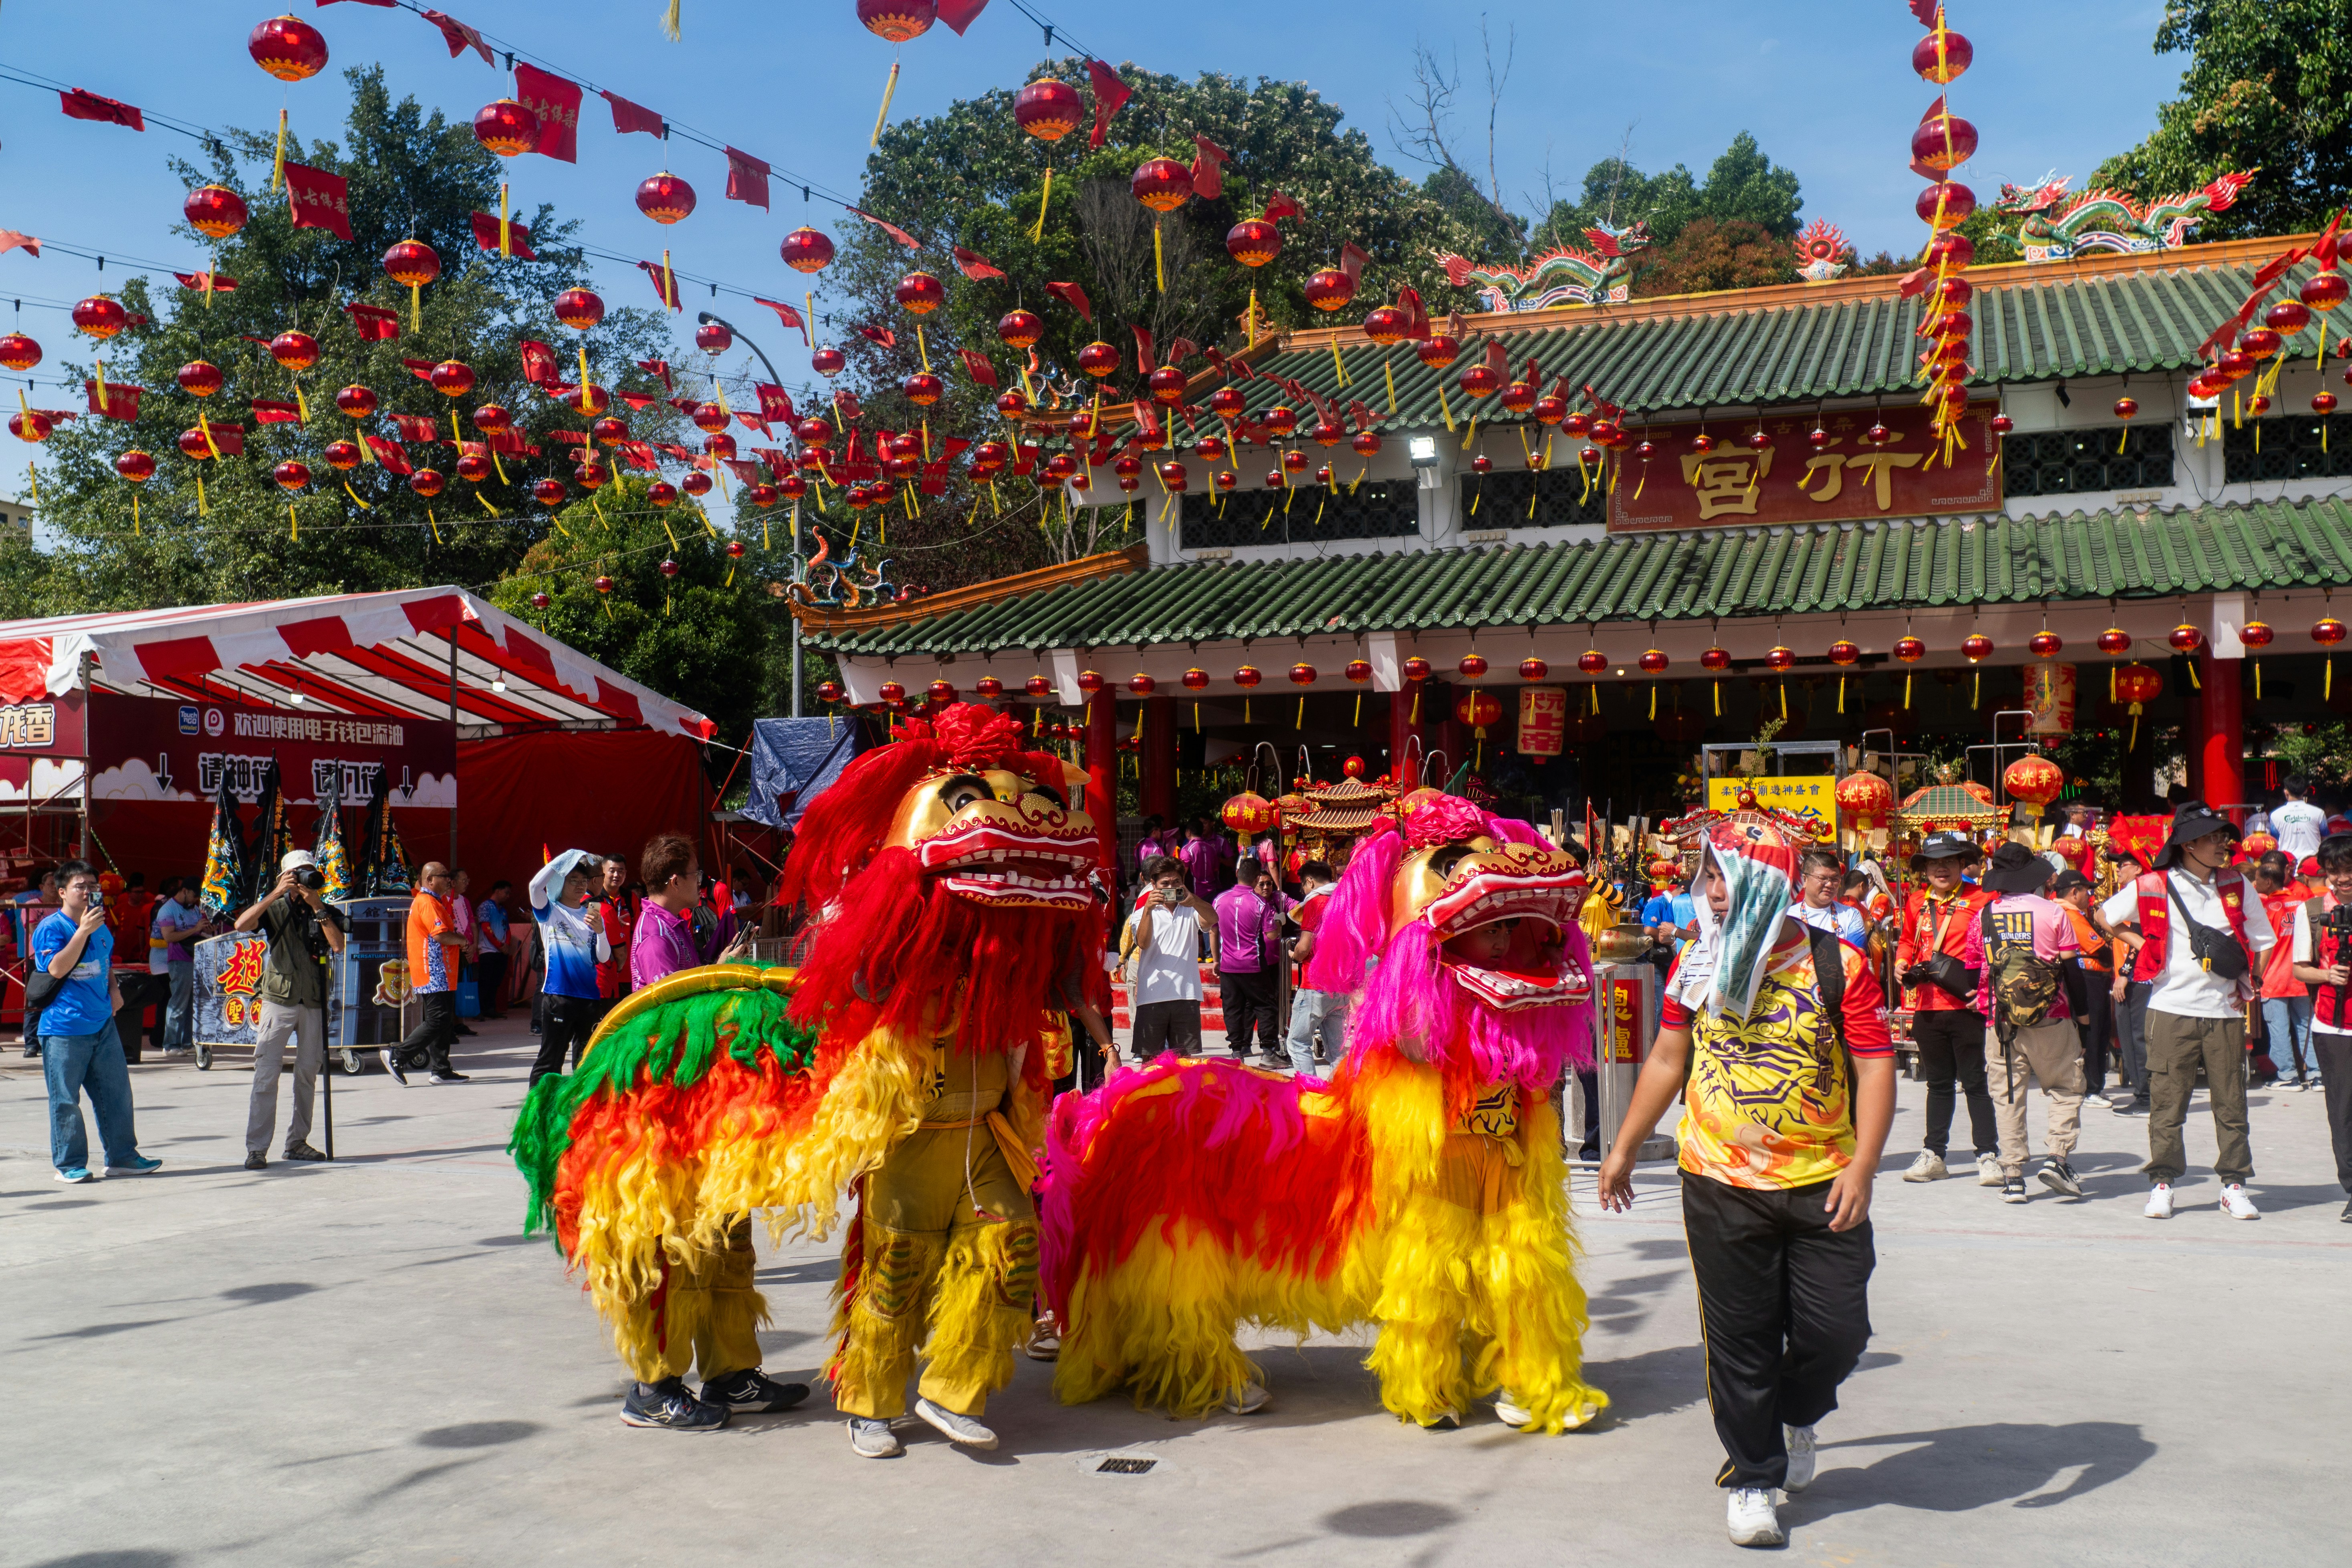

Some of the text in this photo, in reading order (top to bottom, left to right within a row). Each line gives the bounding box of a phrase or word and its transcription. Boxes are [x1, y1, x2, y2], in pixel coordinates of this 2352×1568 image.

[234, 713, 403, 746] 欢迎使用电子钱包添油
[2284, 814, 2311, 823] Carlsberg
